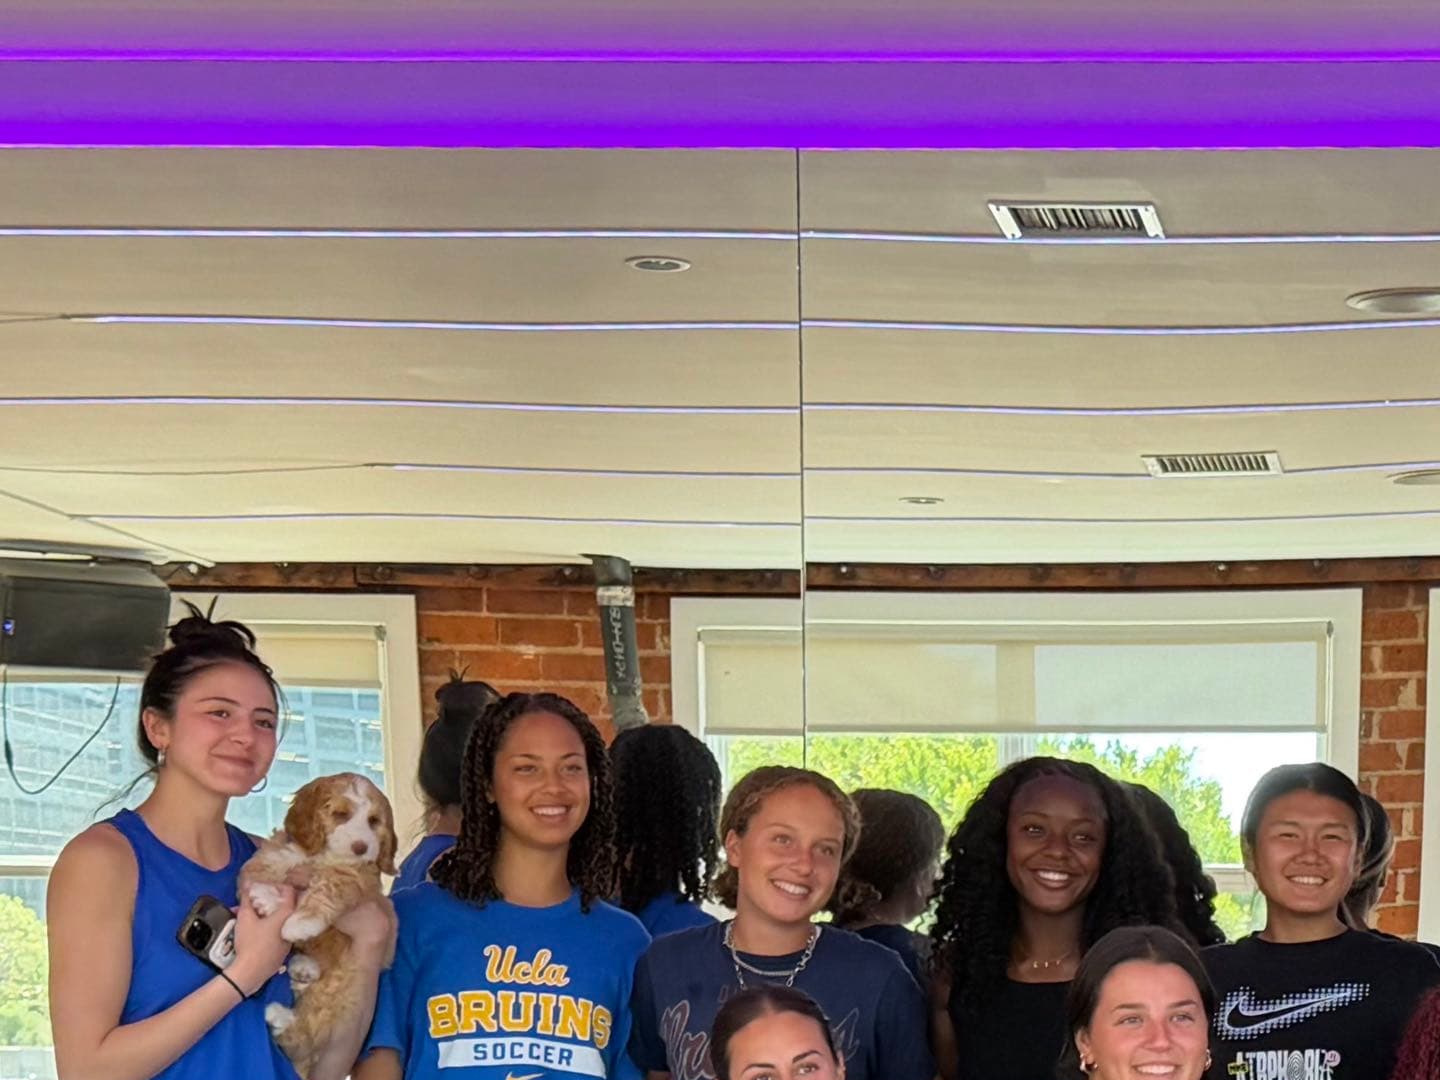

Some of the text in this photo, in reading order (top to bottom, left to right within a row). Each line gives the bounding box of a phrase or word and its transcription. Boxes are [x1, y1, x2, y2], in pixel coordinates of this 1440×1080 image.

[483, 944, 570, 987] Ucla
[427, 990, 612, 1049] BRUINS
[473, 1042, 574, 1067] SOCCER
